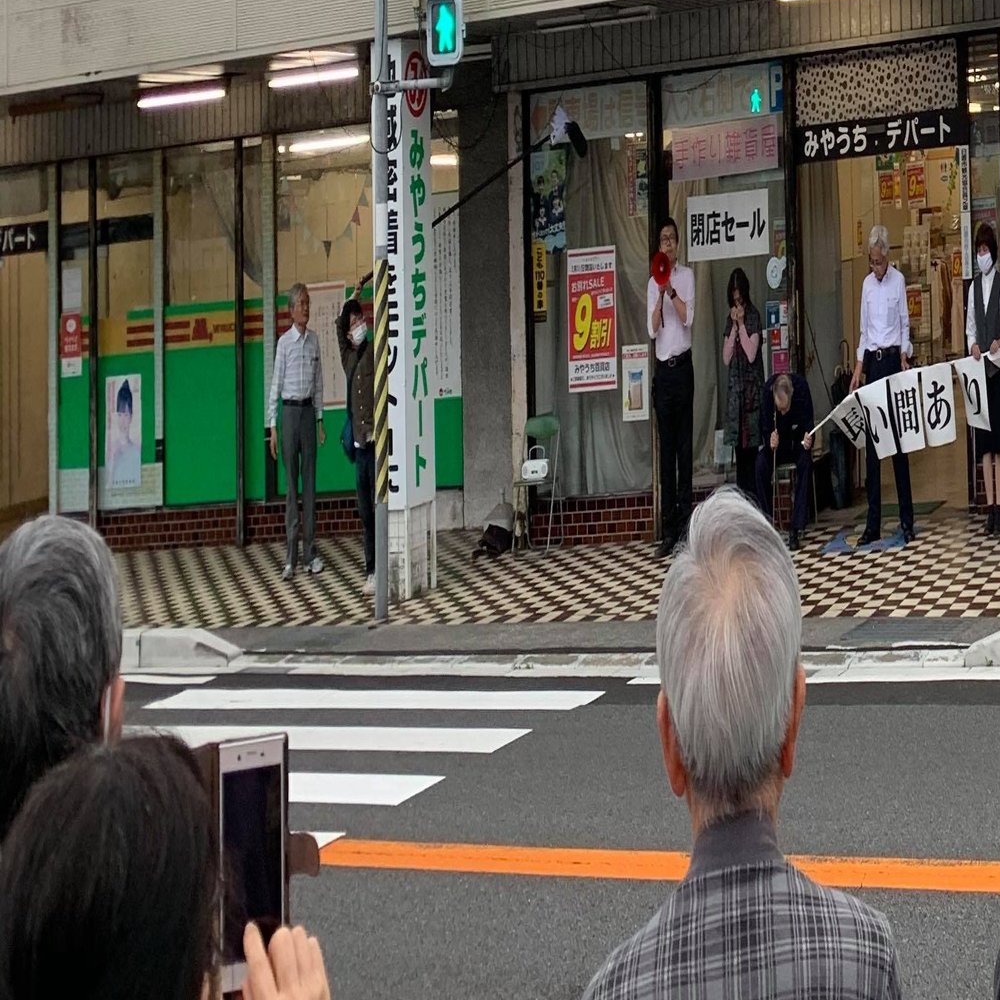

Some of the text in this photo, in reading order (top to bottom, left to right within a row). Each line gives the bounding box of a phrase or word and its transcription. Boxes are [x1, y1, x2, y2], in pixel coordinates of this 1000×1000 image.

[0, 226, 36, 250] パート
[690, 208, 766, 247] 閉店セール
[410, 129, 428, 488] みやうちデパート
[573, 293, 613, 352] 9割引
